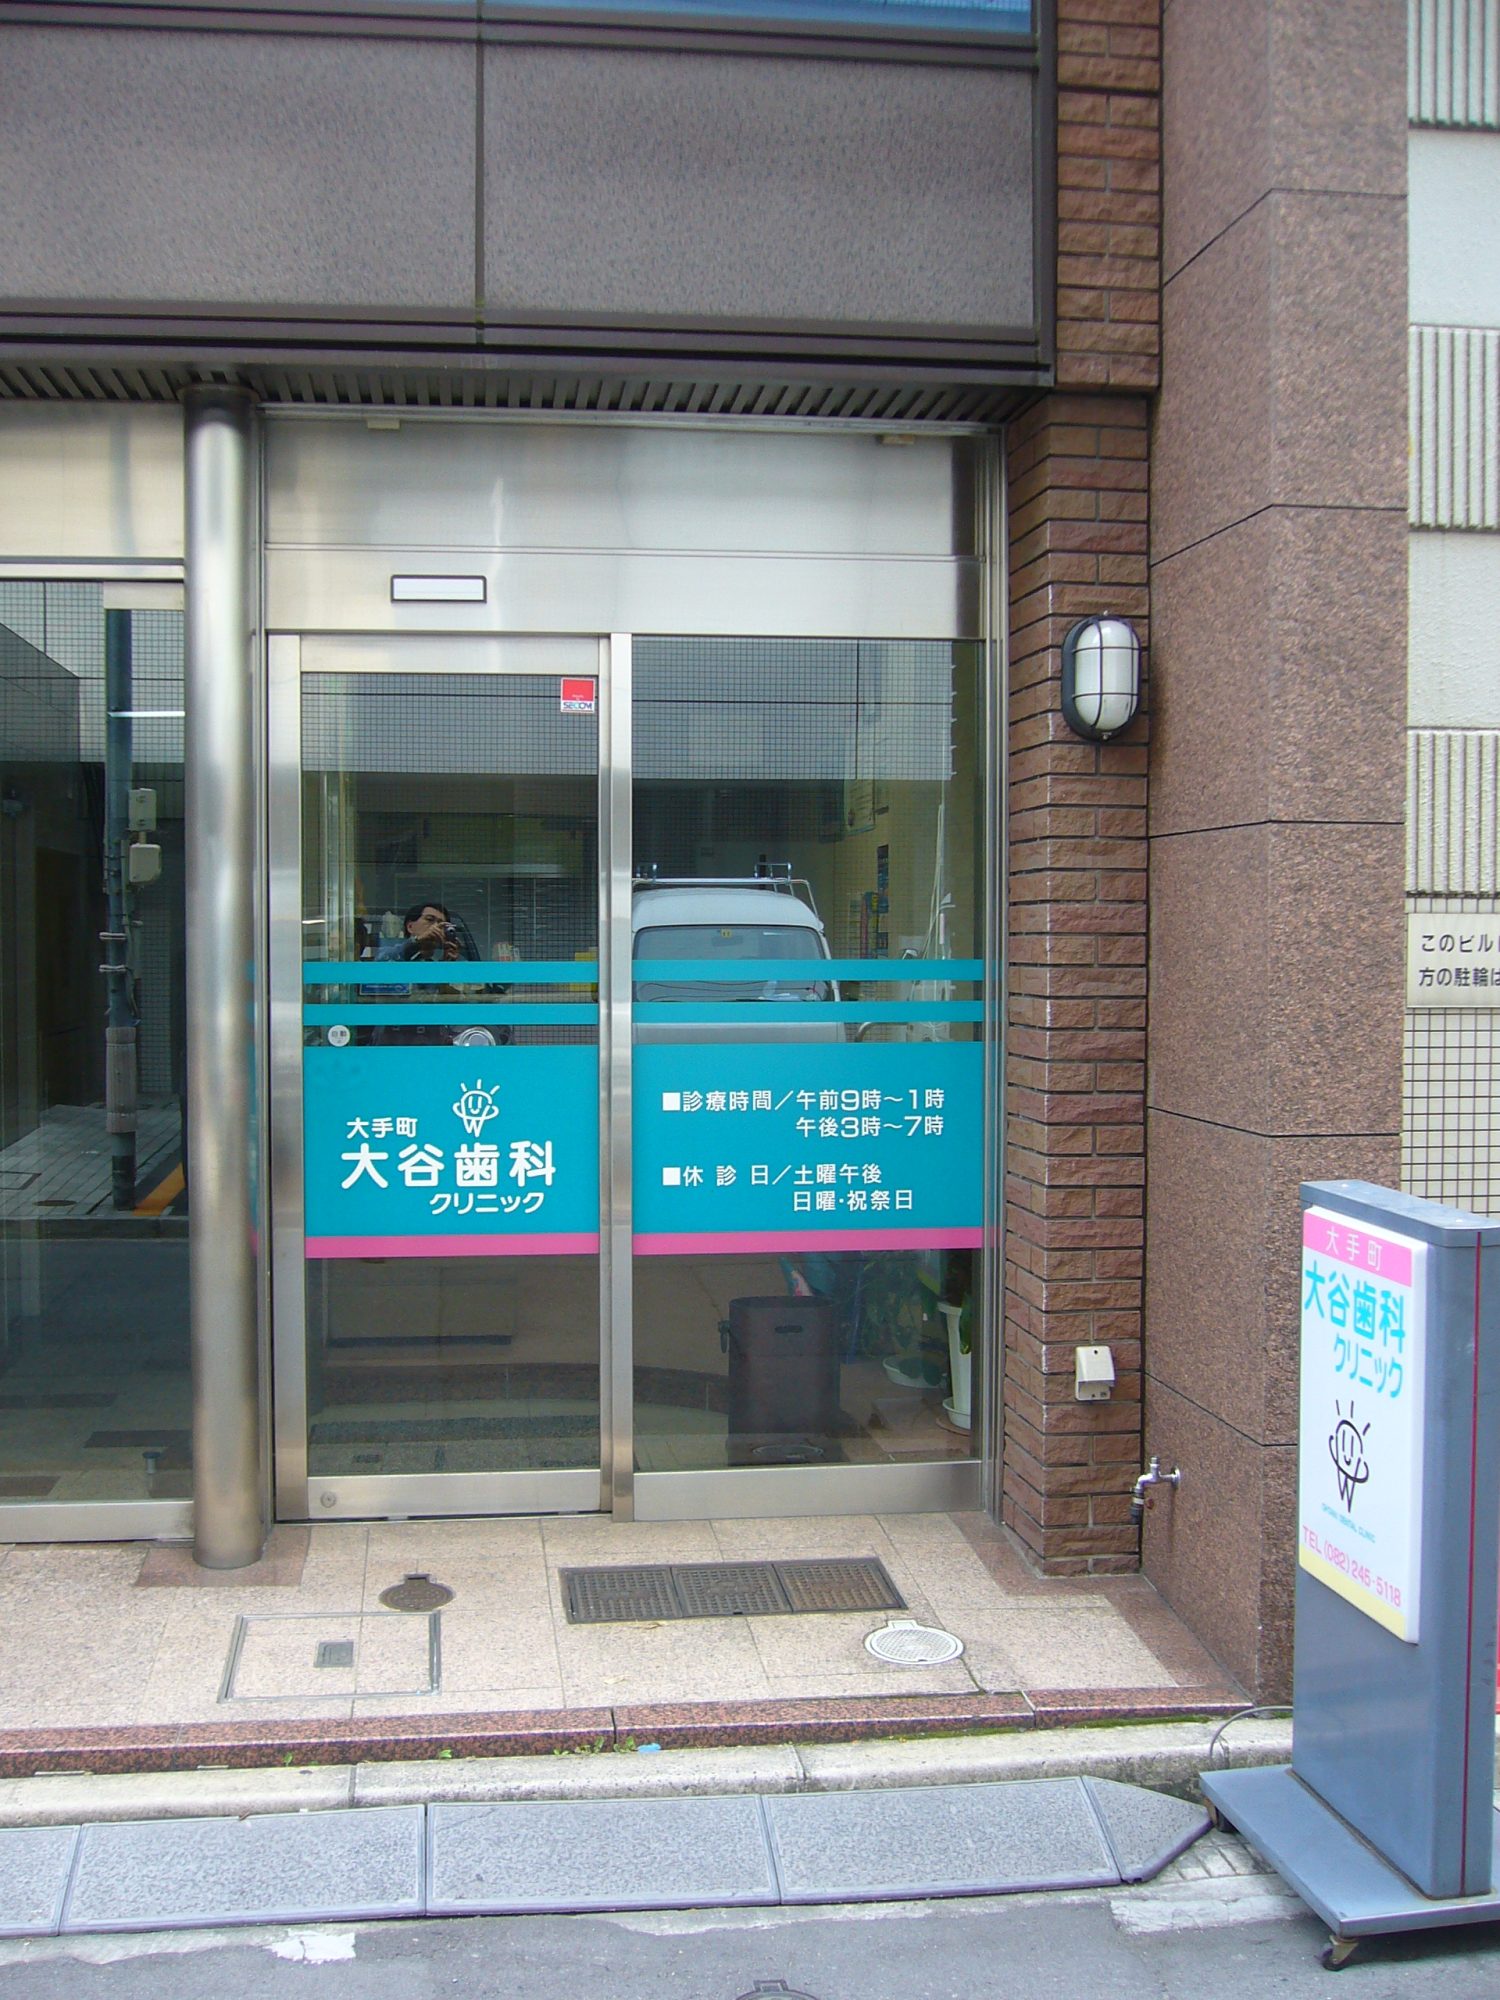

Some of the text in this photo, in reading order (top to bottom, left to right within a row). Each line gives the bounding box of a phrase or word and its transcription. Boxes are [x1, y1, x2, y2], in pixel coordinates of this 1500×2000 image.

[1421, 933, 1500, 953] このビル
[346, 1117, 418, 1139] 大手町
[341, 1140, 556, 1189] 大谷歯科
[430, 1192, 545, 1215] クリニック
[1325, 1226, 1383, 1271] 大手町
[1304, 1260, 1405, 1354] 大谷歯科
[1334, 1333, 1404, 1398] クリニック
[1303, 1524, 1322, 1555] TEL
